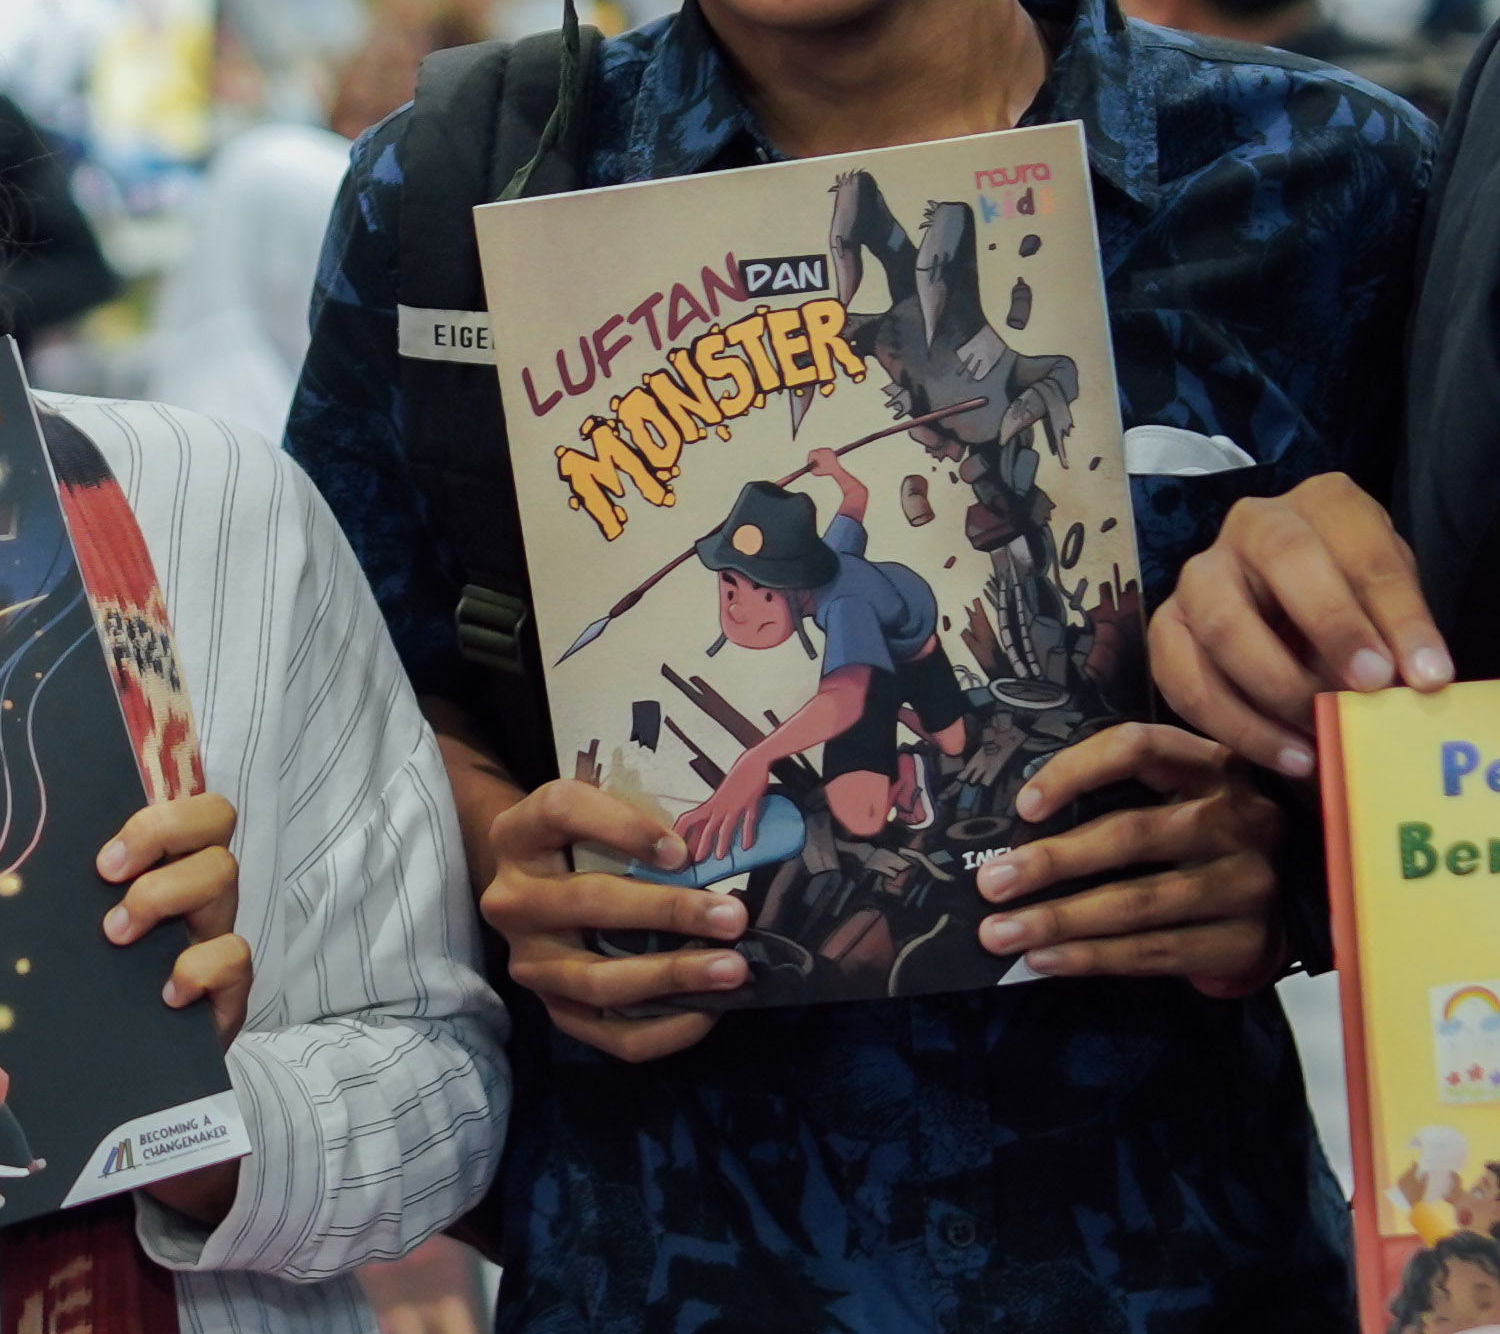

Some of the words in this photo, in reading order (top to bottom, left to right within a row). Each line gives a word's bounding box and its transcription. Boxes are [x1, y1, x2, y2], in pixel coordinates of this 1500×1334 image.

[975, 163, 1051, 190] noura
[978, 186, 1055, 224] kids
[433, 323, 496, 351] EIGE
[522, 251, 749, 417] LUFTAN
[745, 260, 823, 293] DAN
[555, 298, 867, 542] MONSTER
[139, 1118, 199, 1146] BECOMING
[203, 1114, 213, 1127] A
[142, 1124, 229, 1160] CHANGEMAKER
